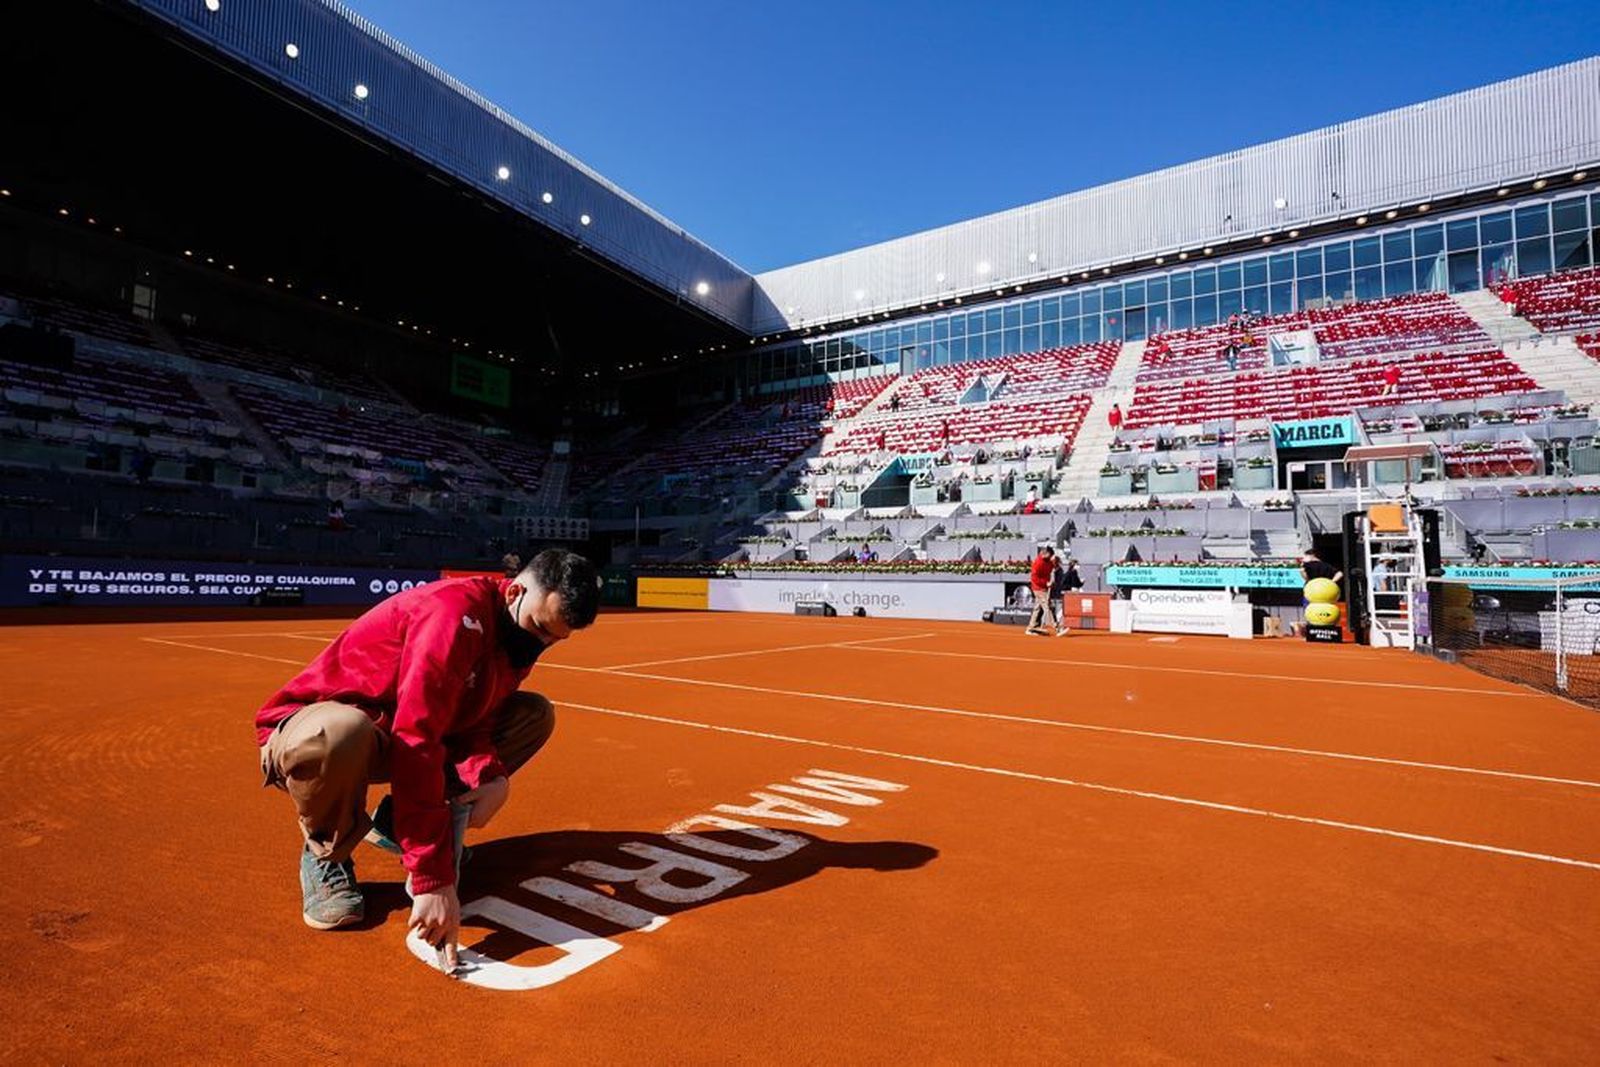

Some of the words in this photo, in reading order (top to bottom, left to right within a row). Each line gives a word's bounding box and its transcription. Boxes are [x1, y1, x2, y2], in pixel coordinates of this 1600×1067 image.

[1279, 423, 1345, 442] MARCA
[901, 457, 932, 470] MARC
[29, 569, 43, 579] Y
[48, 569, 73, 580] TE
[79, 571, 165, 581] BAJAMOS
[170, 573, 190, 582] EL
[195, 573, 251, 584] PRECIO
[255, 575, 274, 584] DE
[277, 576, 356, 586] CUALQUIERA
[1454, 570, 1511, 578] SAMSUNG
[29, 583, 57, 593] DE
[63, 583, 101, 593] TUS
[106, 584, 195, 594] SEGUROS.
[199, 585, 229, 595] SEA
[232, 585, 268, 595] CUA
[843, 590, 905, 610] change.
[1138, 591, 1206, 605] Openbank
[405, 768, 910, 991] MADRID
